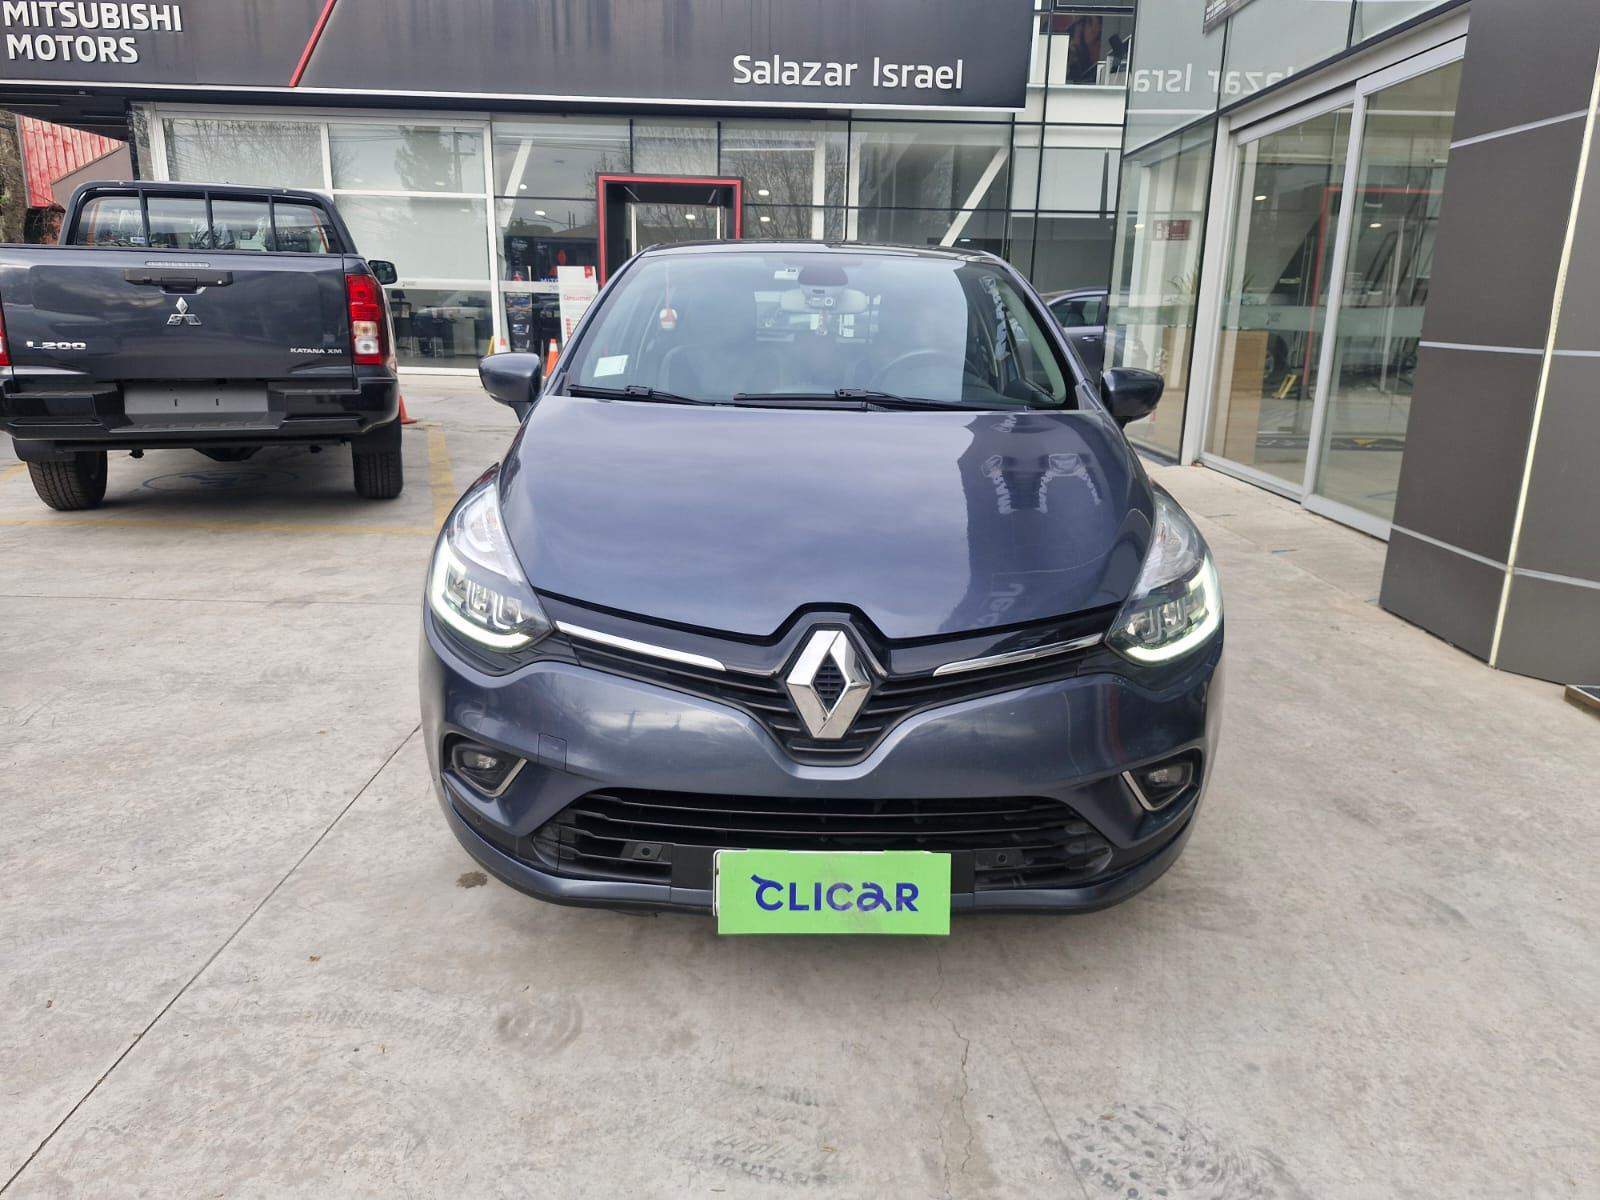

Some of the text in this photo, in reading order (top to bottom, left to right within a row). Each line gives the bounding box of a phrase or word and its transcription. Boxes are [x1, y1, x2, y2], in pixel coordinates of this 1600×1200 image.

[3, 1, 183, 32] MITSUBISHI
[6, 34, 139, 64] MOTORS
[733, 54, 963, 90] Salazar Israel
[26, 341, 87, 350] L200
